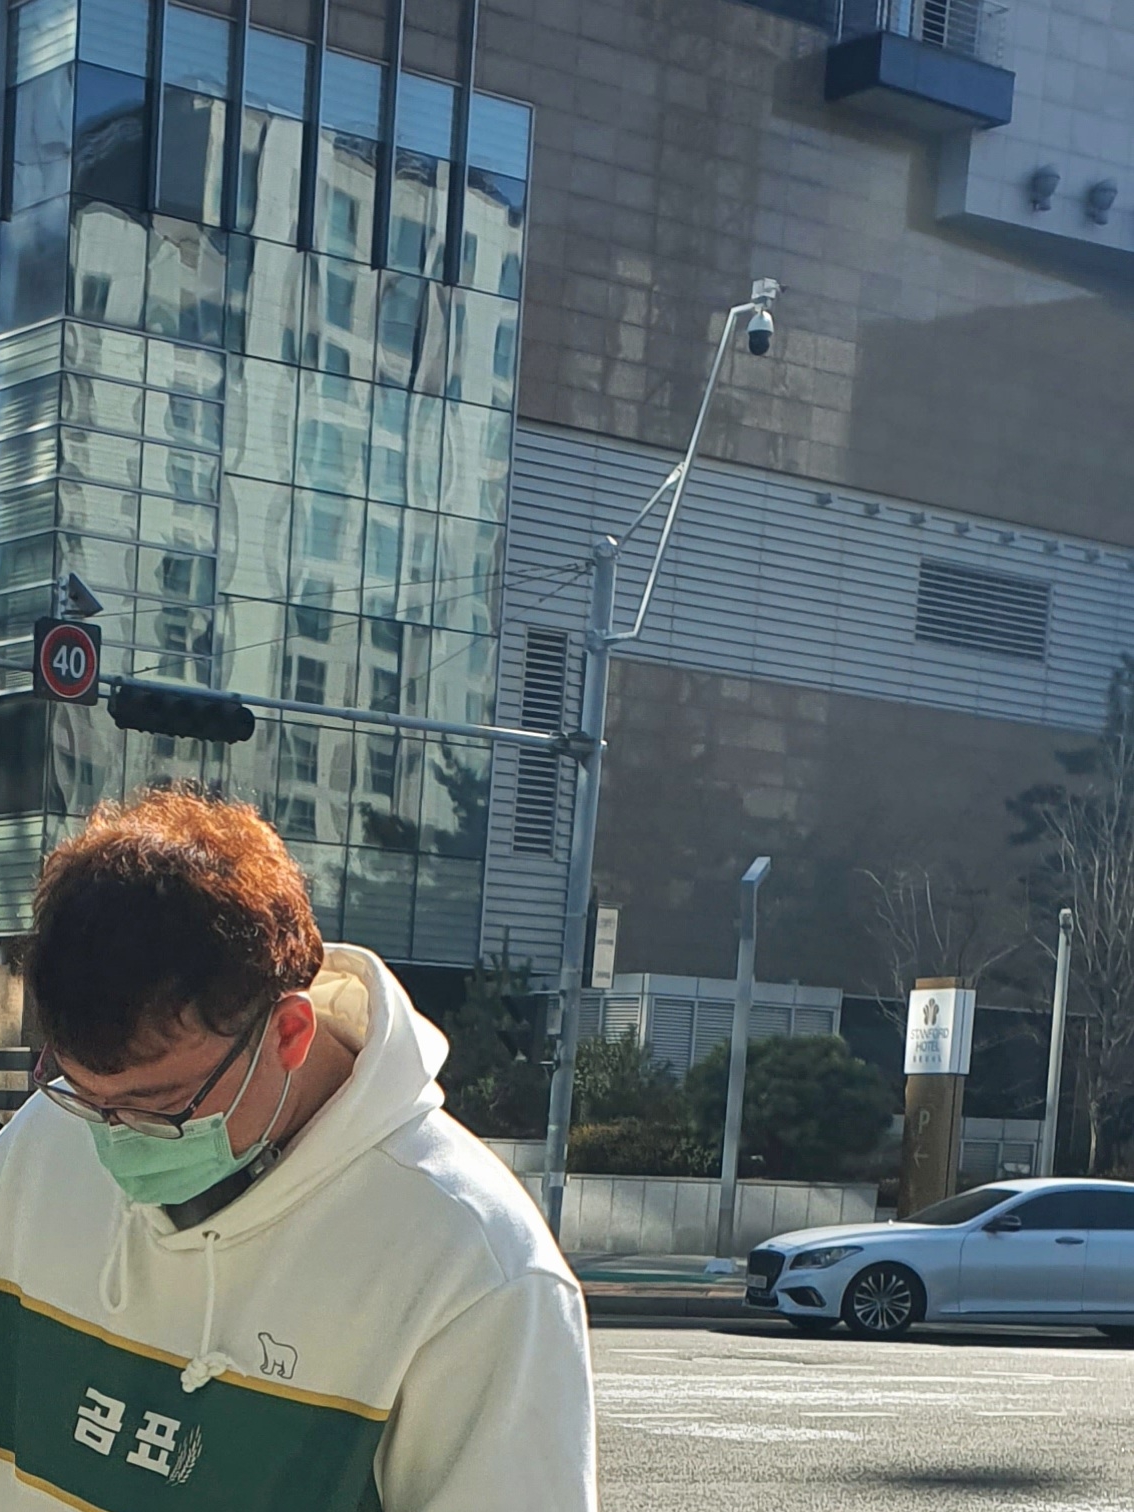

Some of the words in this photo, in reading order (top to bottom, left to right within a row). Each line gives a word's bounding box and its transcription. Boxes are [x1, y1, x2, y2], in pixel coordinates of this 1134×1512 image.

[53, 645, 85, 679] 40
[916, 1041, 940, 1053] HOTEL
[74, 1387, 181, 1477] 곰표
